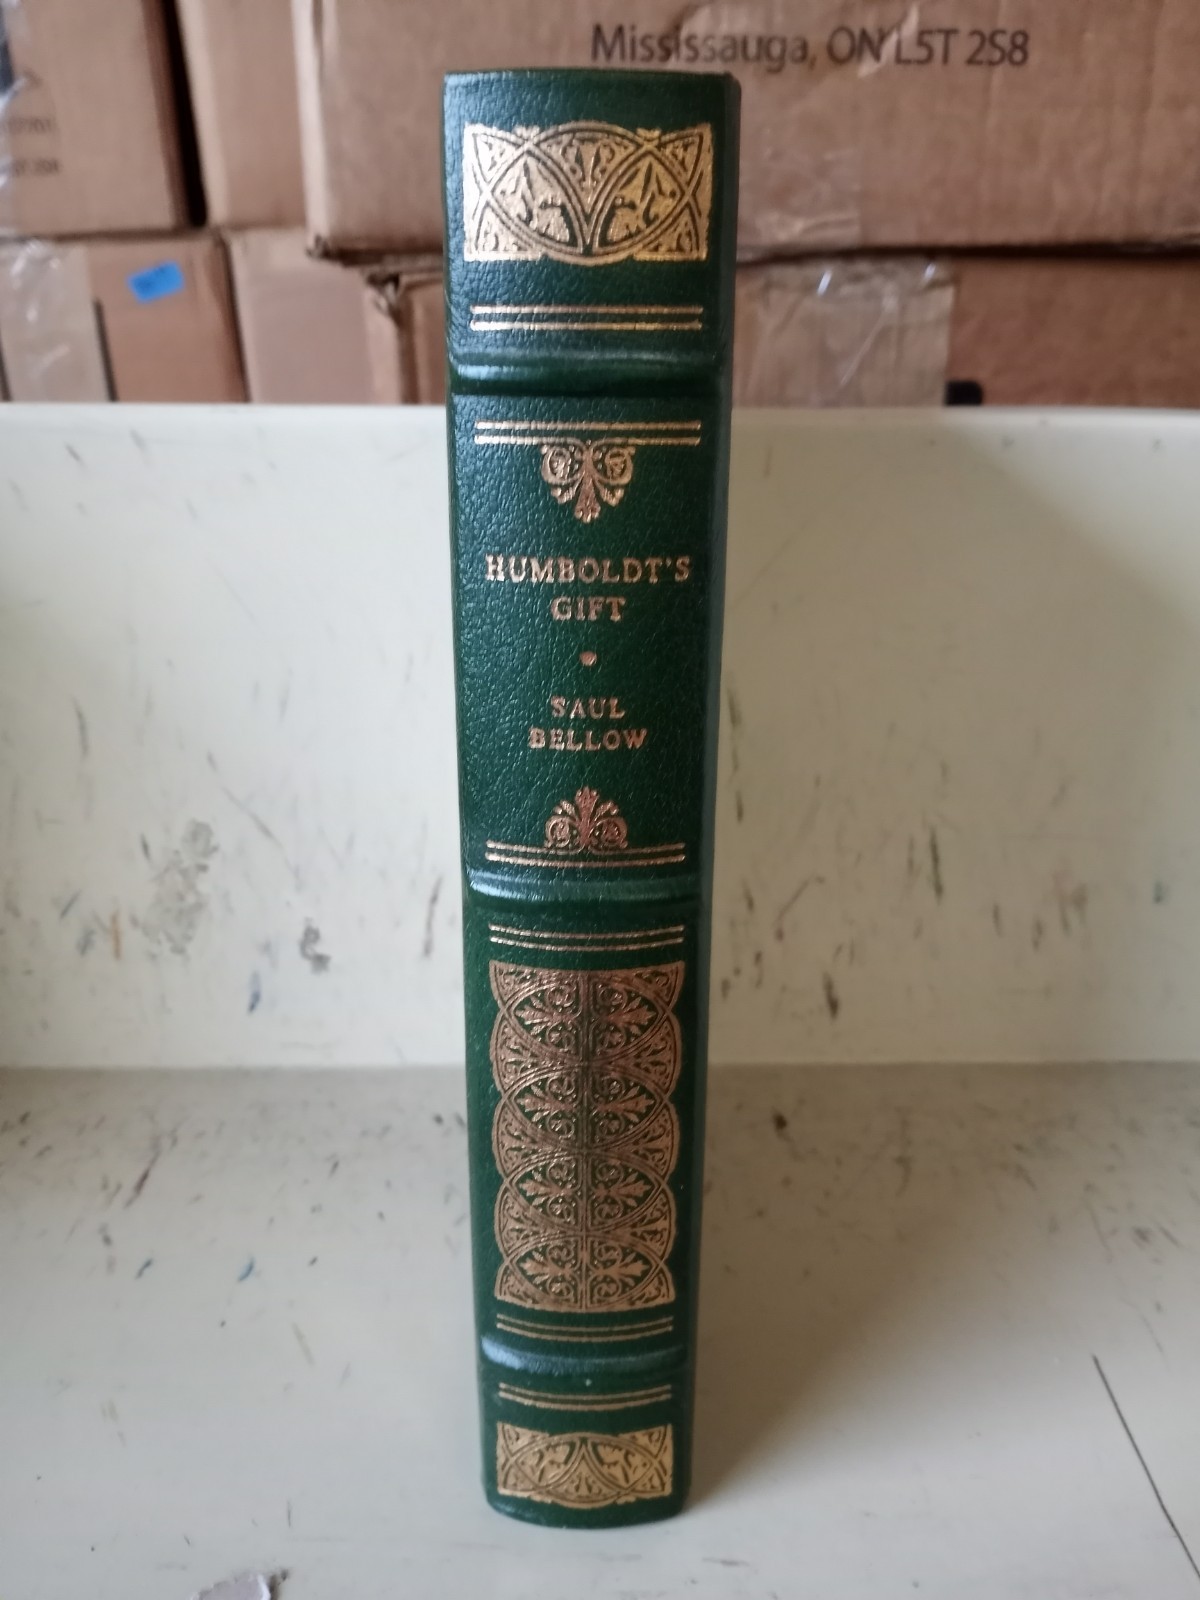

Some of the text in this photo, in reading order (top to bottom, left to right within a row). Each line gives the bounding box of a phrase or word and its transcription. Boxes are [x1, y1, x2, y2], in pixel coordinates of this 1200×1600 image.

[591, 23, 1029, 72] Mississauga, ON L5T 2S8
[485, 554, 690, 583] HUMBOLDT'S
[551, 596, 626, 621] GIFT
[551, 696, 626, 719] SAUL
[528, 728, 648, 750] BELLOW
